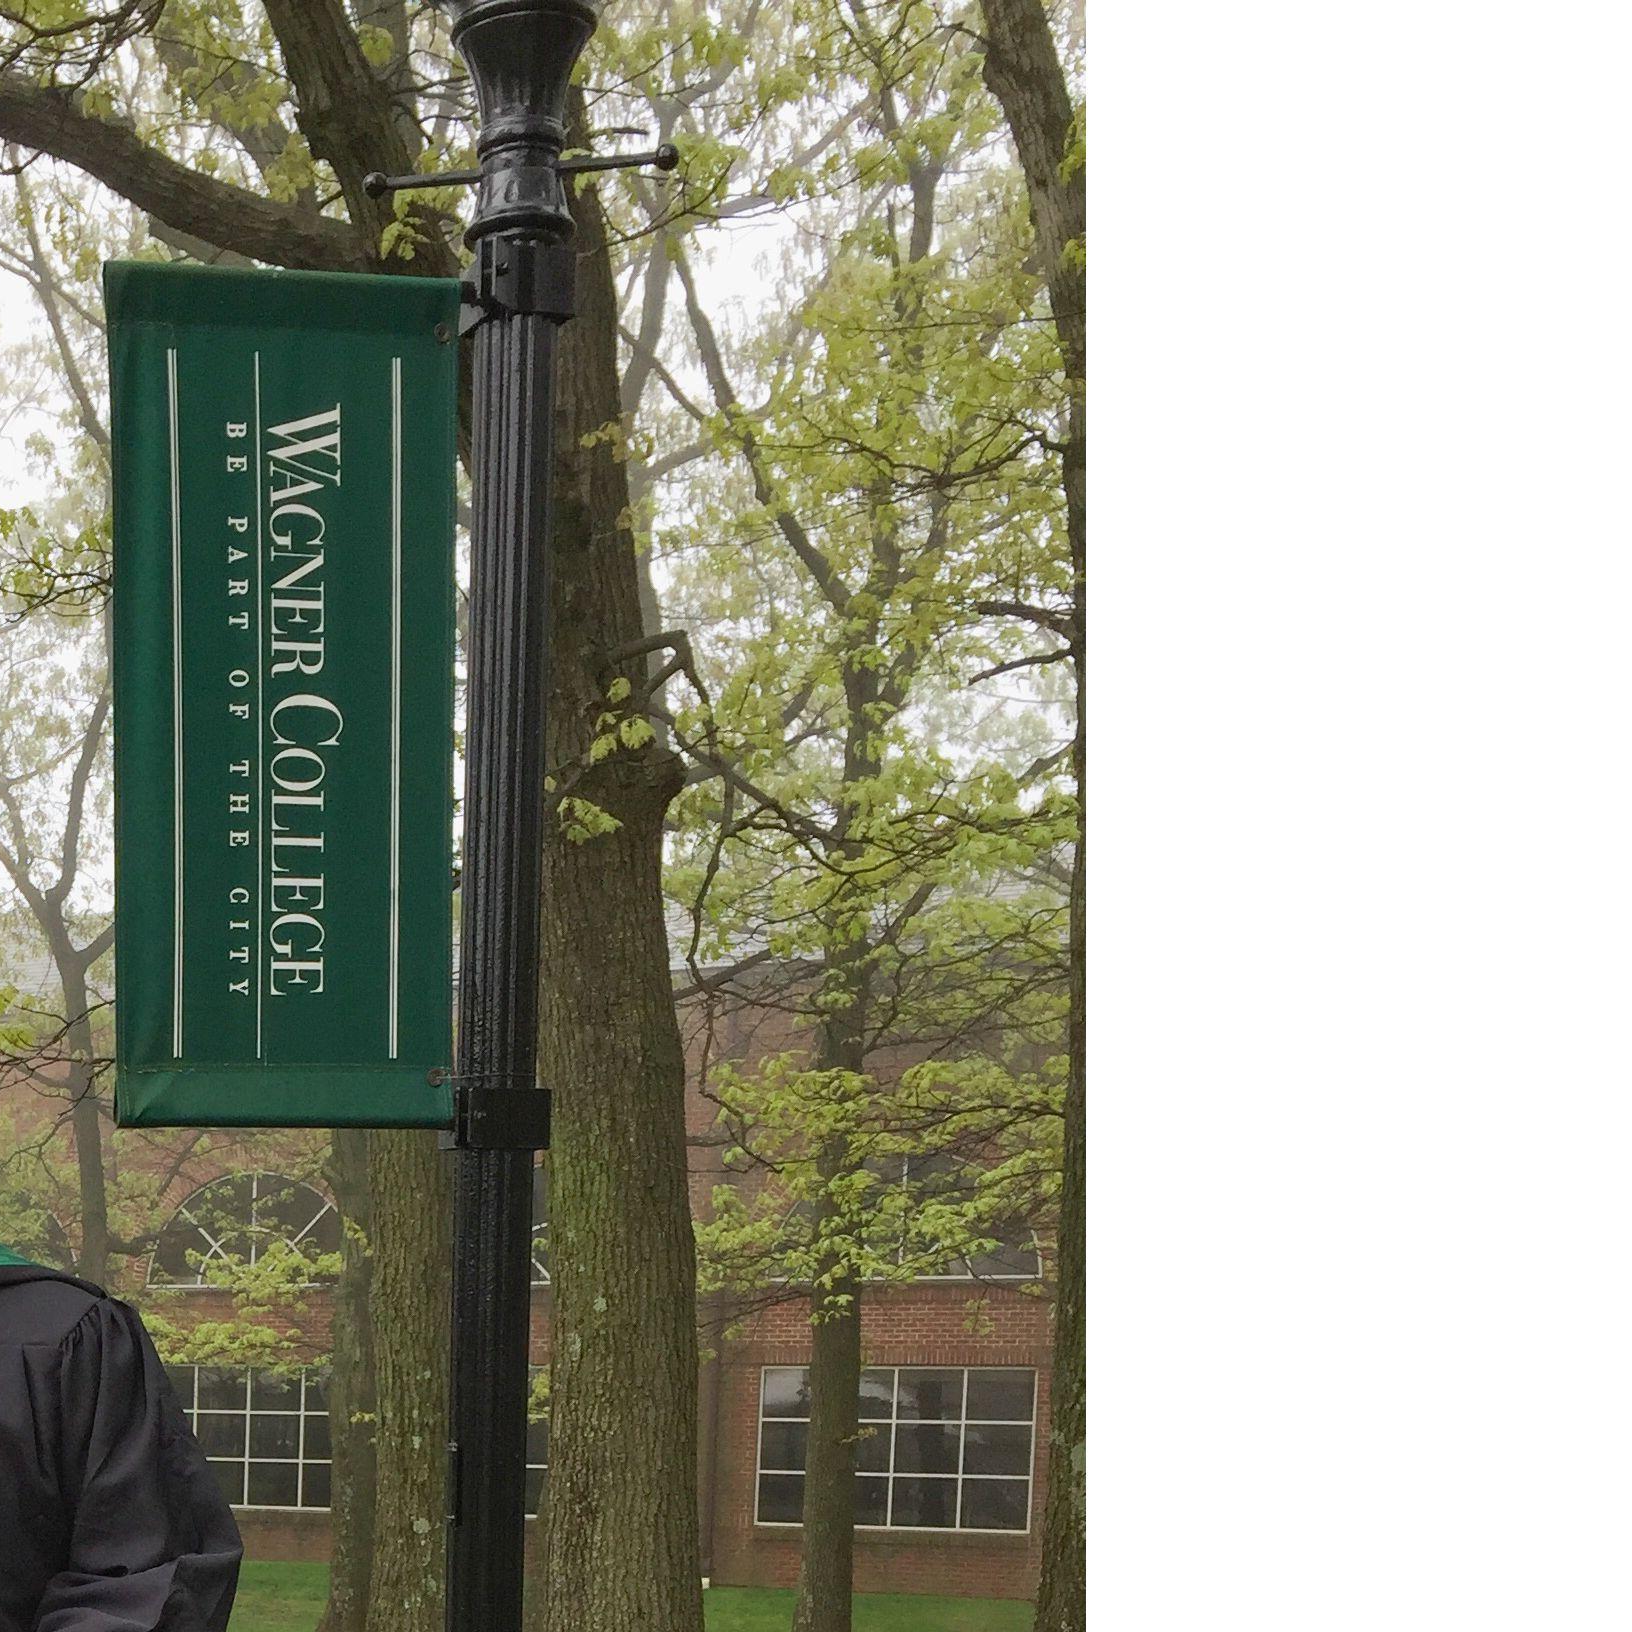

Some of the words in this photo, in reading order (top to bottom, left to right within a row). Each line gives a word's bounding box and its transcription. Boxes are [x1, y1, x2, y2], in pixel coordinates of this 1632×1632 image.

[226, 421, 248, 473] BE
[227, 516, 249, 630] PART
[266, 402, 341, 679] WAGNER
[228, 669, 250, 720] OF
[229, 759, 250, 847] THE
[269, 693, 344, 996] COLLEGE
[229, 887, 250, 996] CITY
